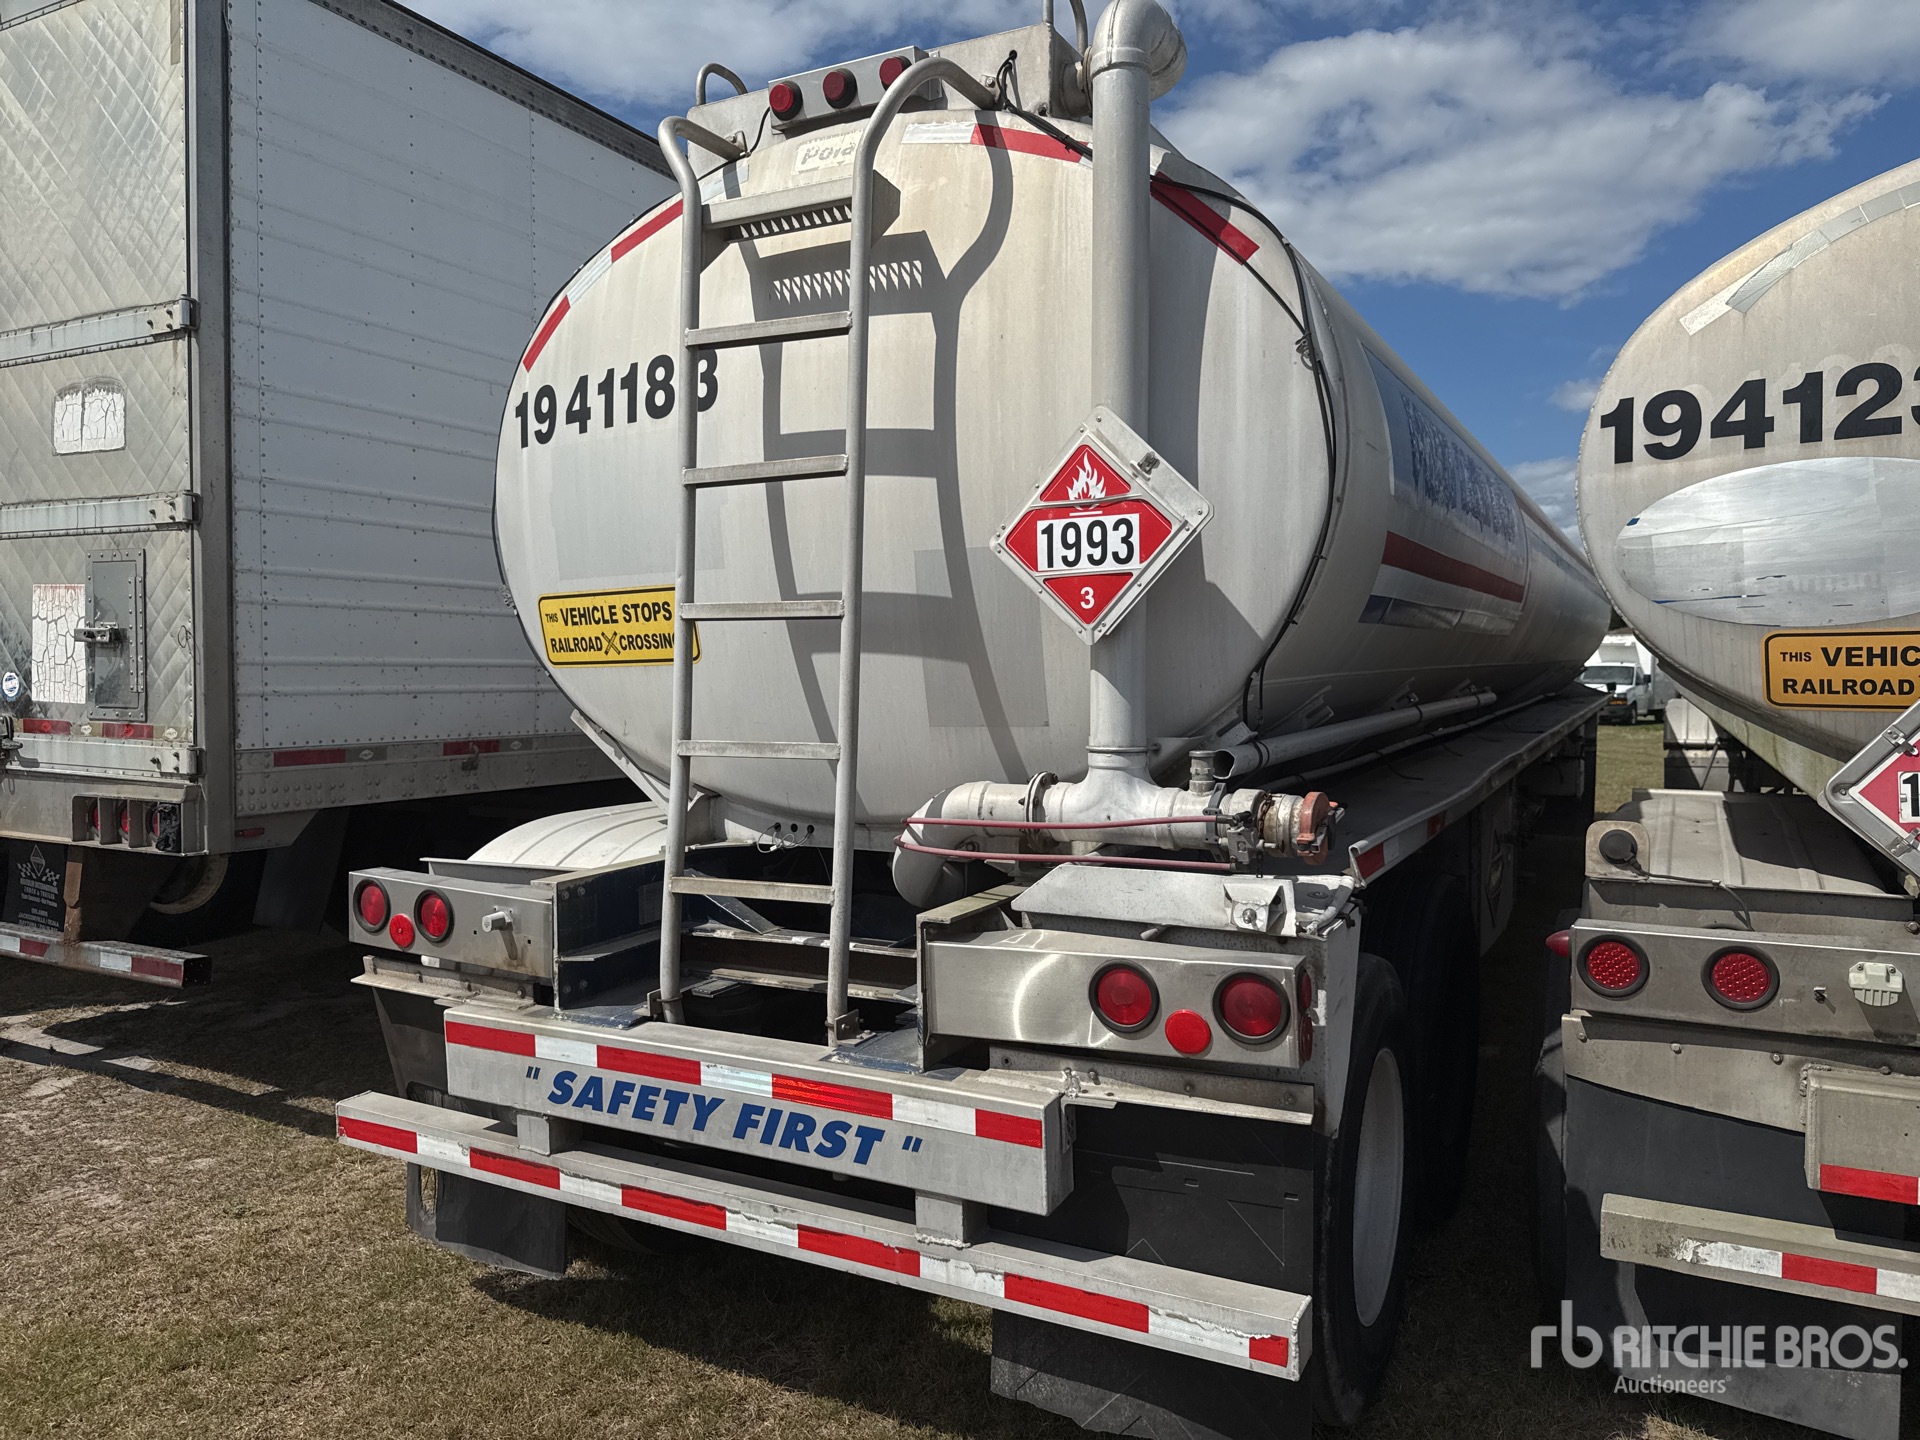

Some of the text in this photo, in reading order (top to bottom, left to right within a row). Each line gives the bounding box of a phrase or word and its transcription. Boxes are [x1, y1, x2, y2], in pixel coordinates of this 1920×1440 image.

[1600, 362, 1920, 465] 19412
[1041, 517, 1135, 569] 1993
[1080, 586, 1095, 610] 3
[545, 601, 673, 627] THIS VEHICLE STOPS
[550, 632, 675, 653] RAILROAD CROSSIN
[1780, 651, 1812, 662] THIS
[1782, 678, 1915, 696] RAILROAD
[547, 1069, 725, 1132] SAFETY
[732, 1102, 886, 1166] FIRST
